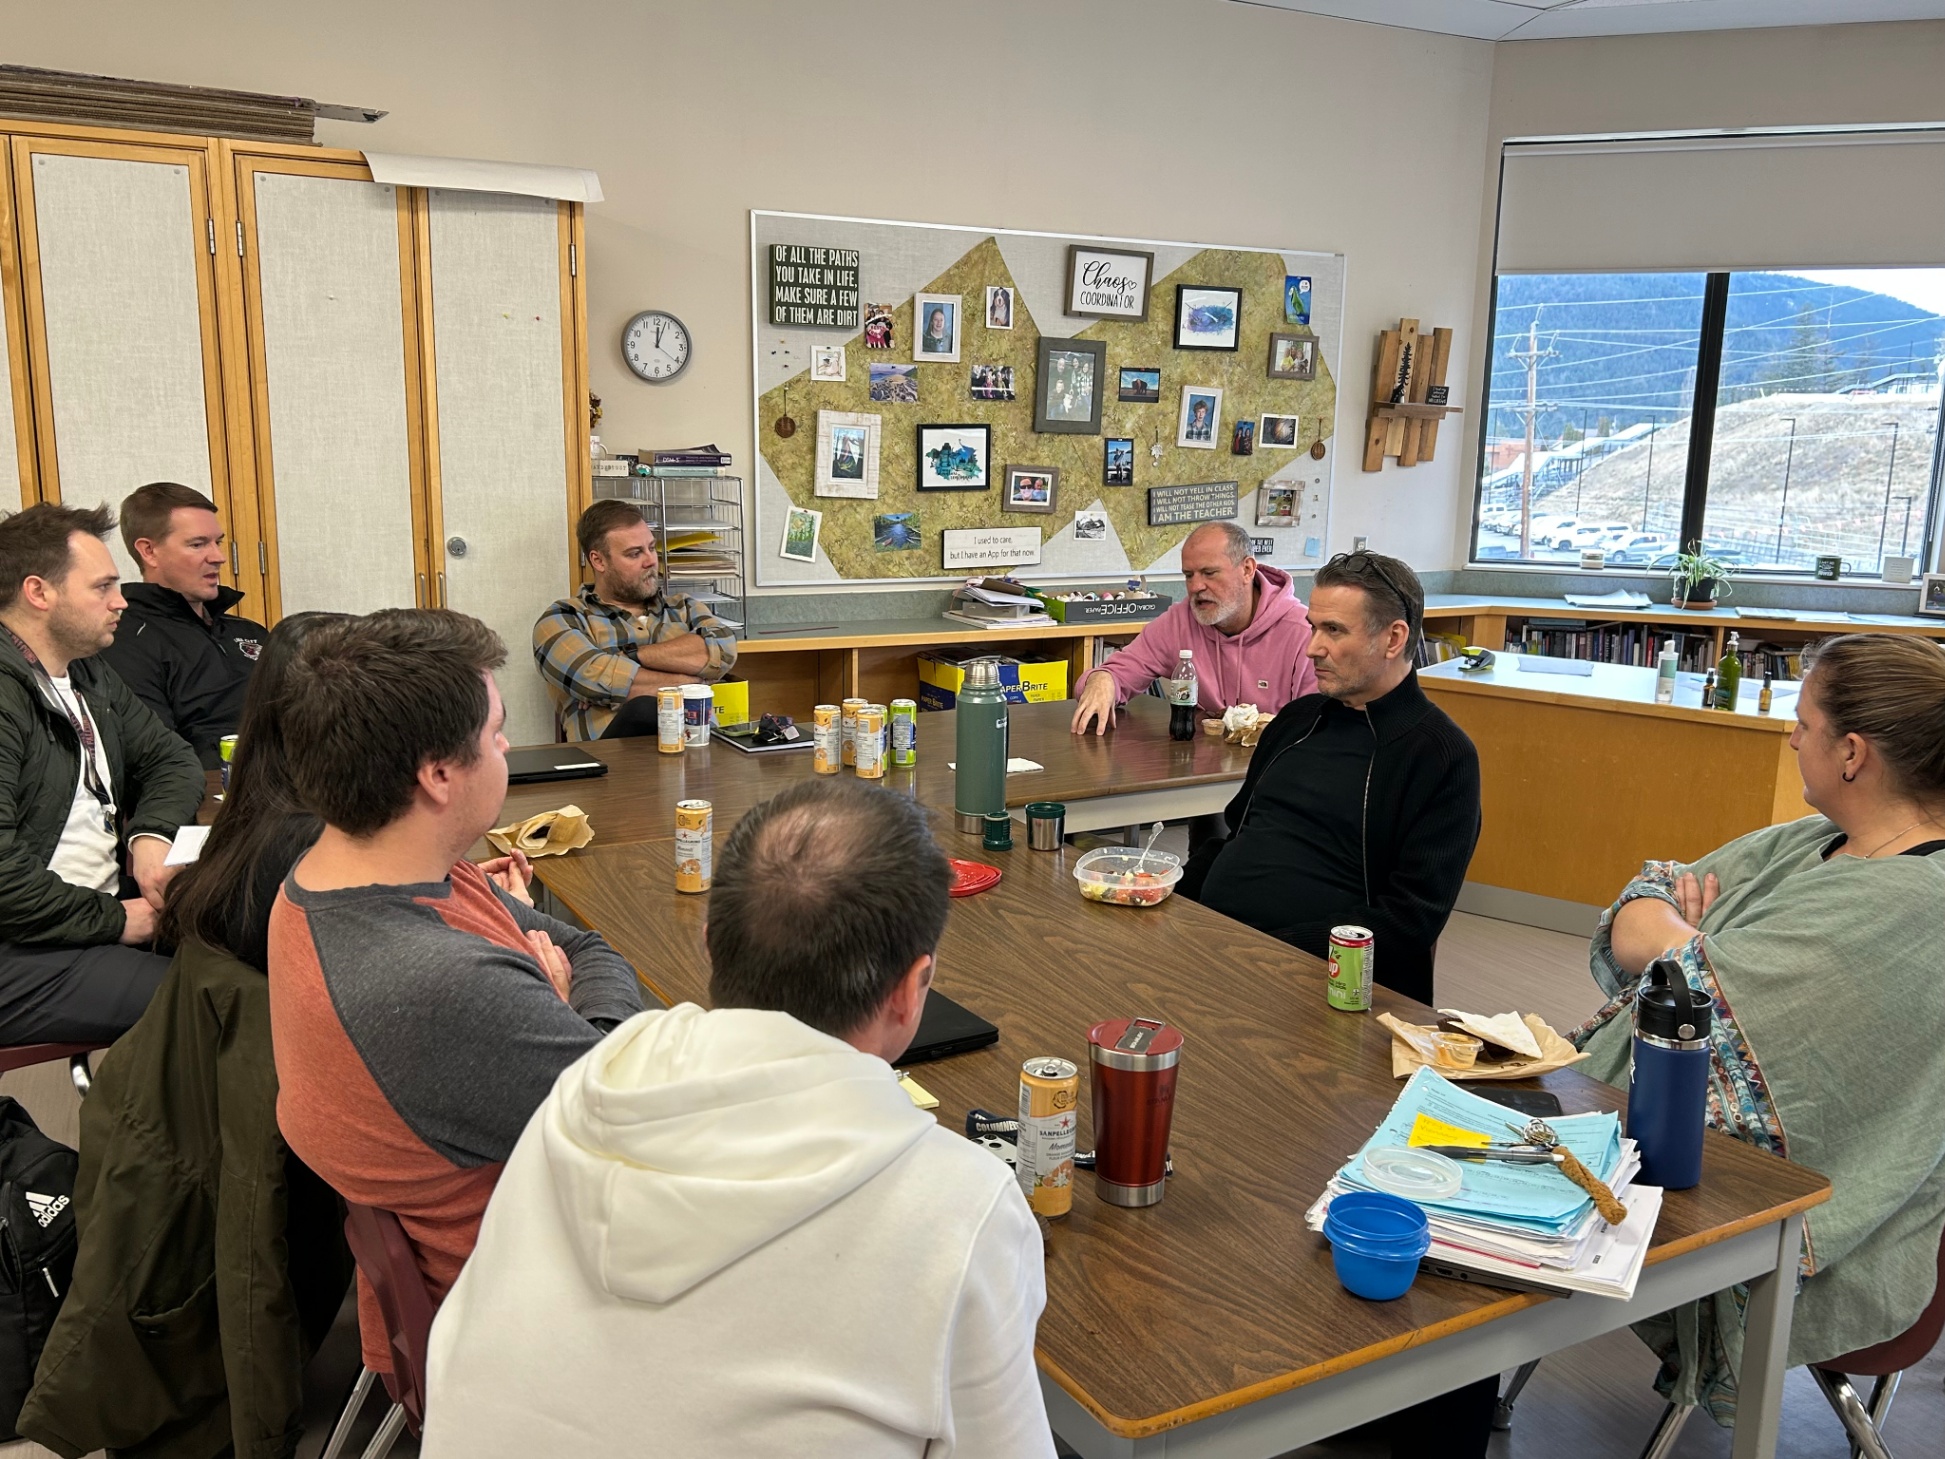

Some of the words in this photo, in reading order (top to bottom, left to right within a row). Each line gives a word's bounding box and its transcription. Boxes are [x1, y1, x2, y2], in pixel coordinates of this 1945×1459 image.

[776, 246, 787, 262] OF
[790, 246, 806, 264] ALL
[809, 248, 826, 265] THE
[829, 249, 858, 267] PATHS
[776, 266, 794, 282] YOU
[798, 267, 821, 284] TAKE
[824, 269, 834, 285] IN
[837, 270, 858, 288] LIFE,
[1083, 260, 1128, 295] Chaos
[776, 286, 802, 303] MAKE
[804, 288, 828, 305] SURE
[830, 290, 836, 306] A
[839, 290, 858, 306] FEW
[1080, 291, 1134, 309] COORDINATOR
[653, 318, 661, 326] 12
[776, 306, 787, 322] OF
[789, 307, 814, 324] THEM
[816, 308, 834, 325] ARE
[837, 309, 858, 326] DIRT
[643, 321, 648, 329] 11
[674, 356, 680, 364] 4
[1158, 513, 1172, 522] AM
[1174, 511, 1192, 520] THE
[1194, 507, 1234, 518] TEACHER.
[978, 536, 991, 544] used
[950, 551, 960, 559] but
[965, 550, 978, 559] have
[988, 550, 999, 560] App
[1001, 549, 1009, 557] for
[1100, 603, 1136, 615] OFFICE
[1329, 962, 1339, 976] up
[38, 1195, 70, 1228] adidas
